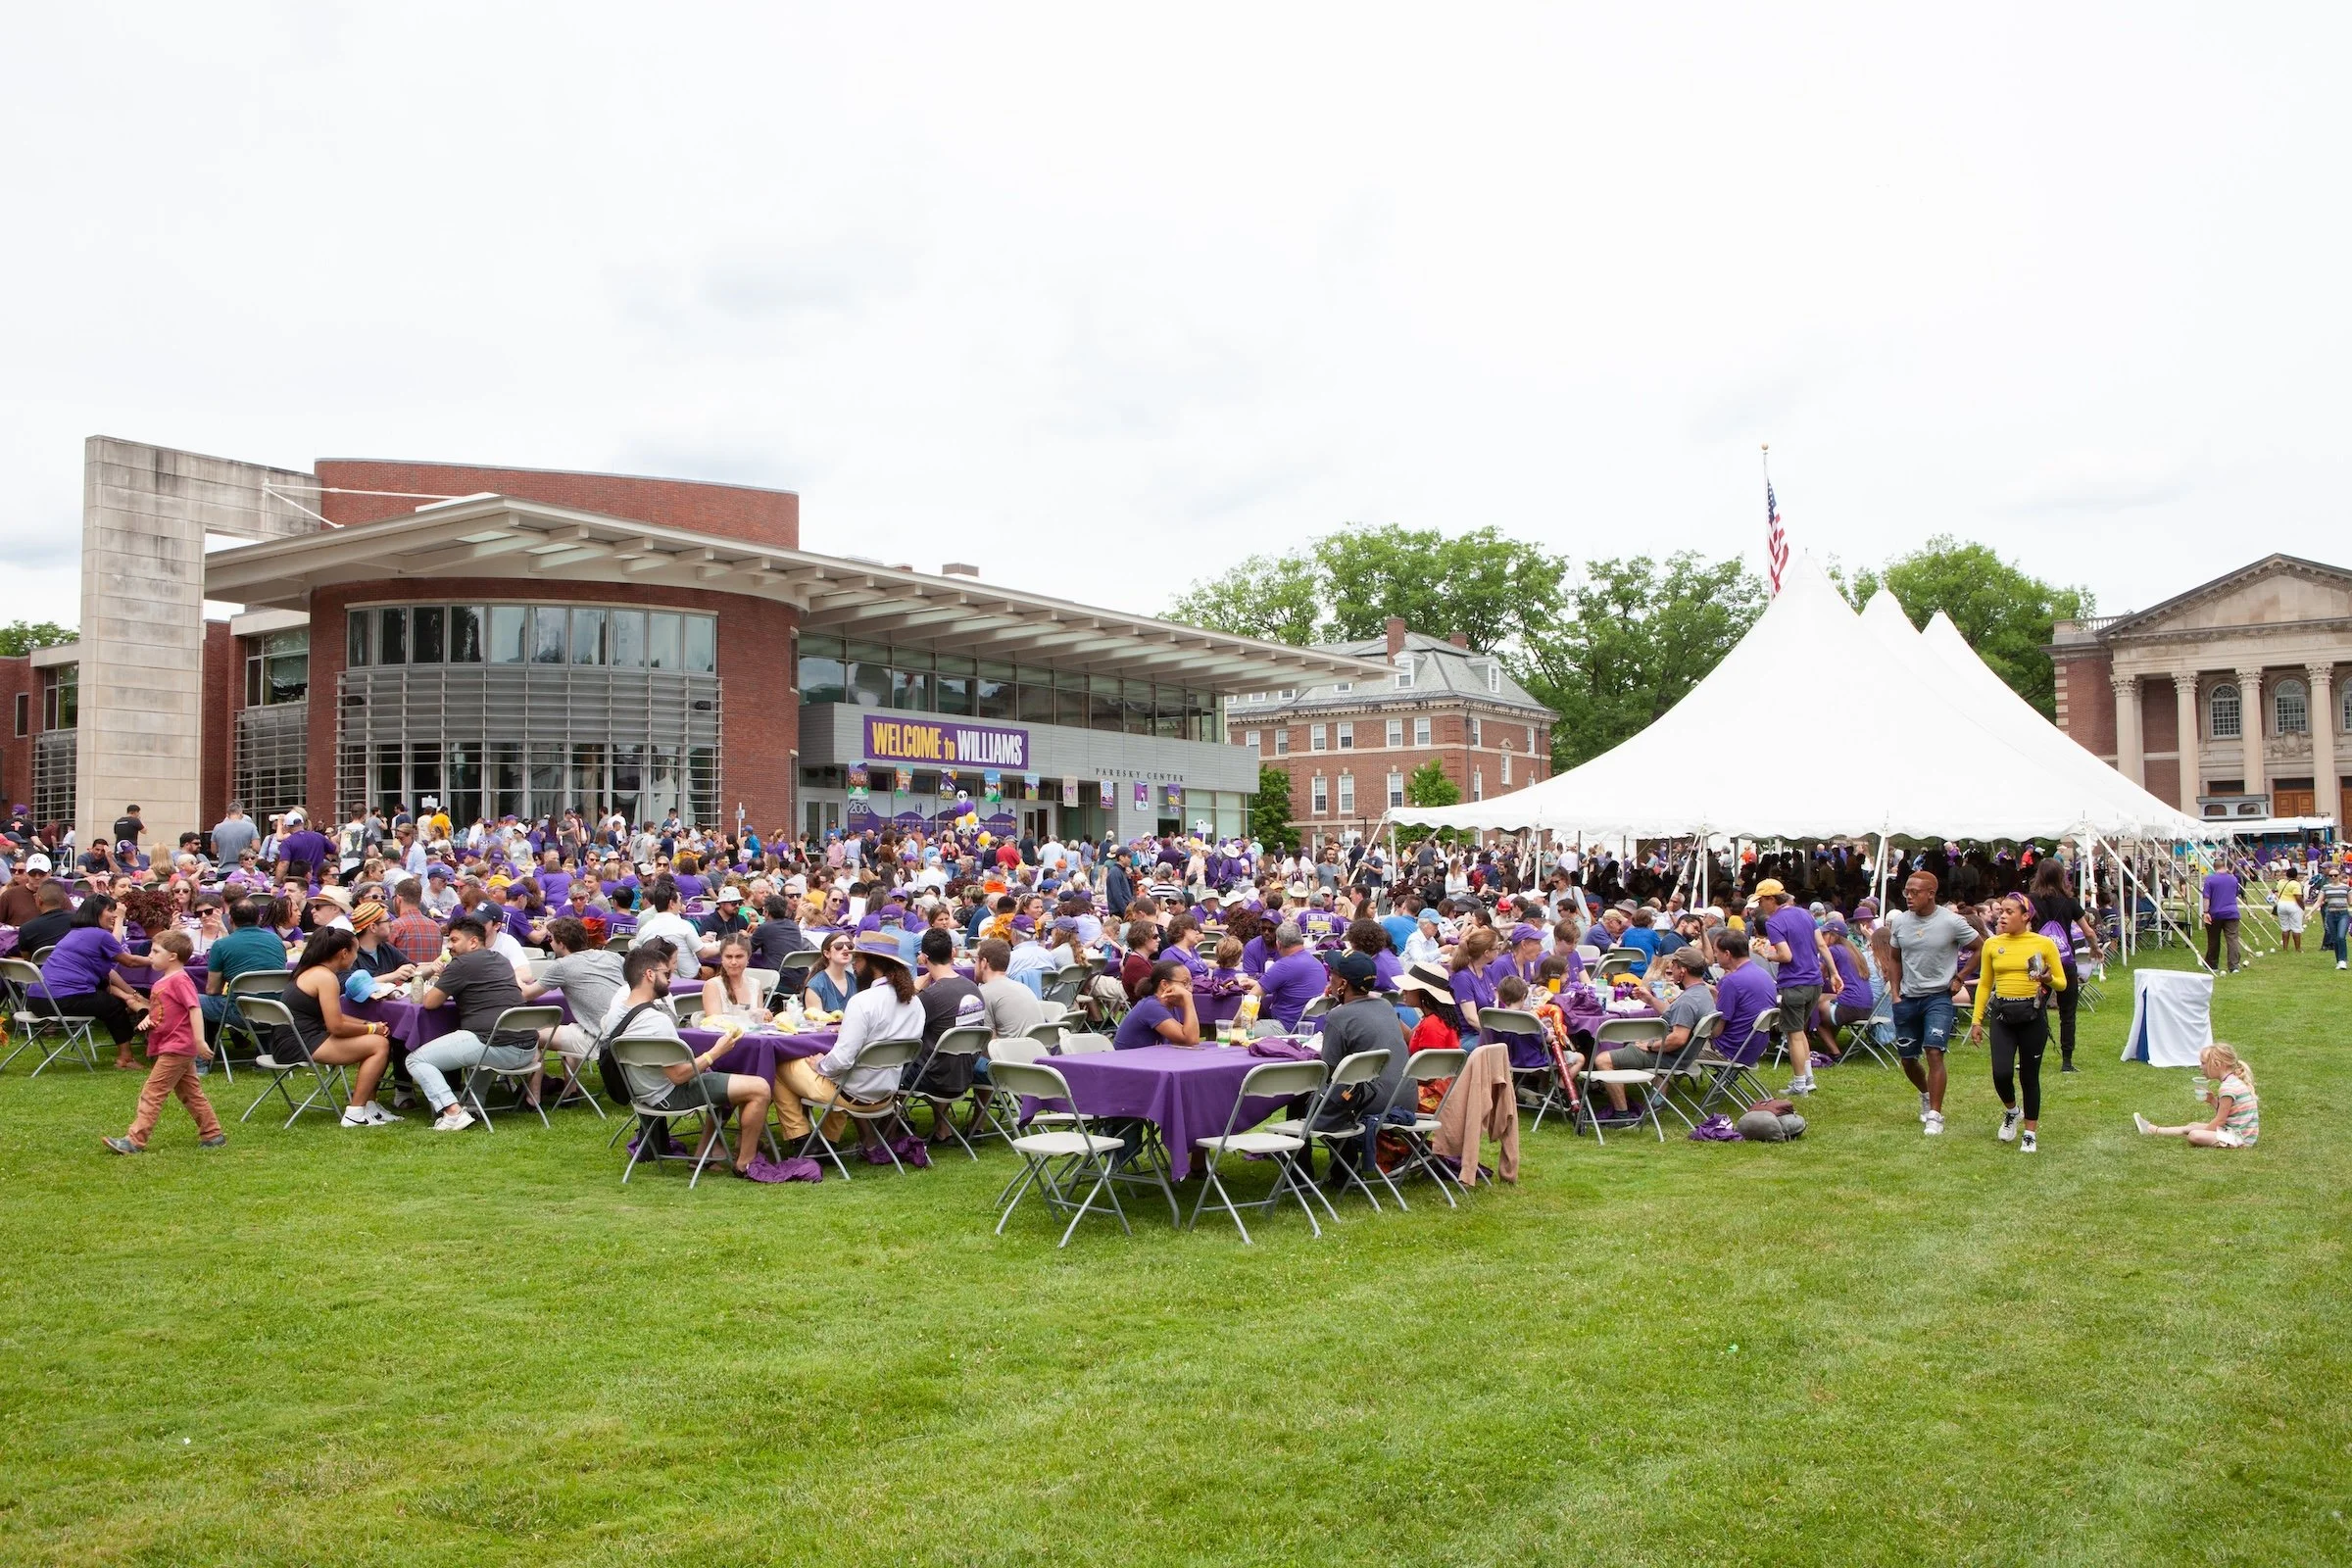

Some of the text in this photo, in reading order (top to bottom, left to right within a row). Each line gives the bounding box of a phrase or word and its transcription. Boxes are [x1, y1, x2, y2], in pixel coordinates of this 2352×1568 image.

[872, 721, 1023, 766] WELCOME to WILLIAMS
[1096, 767, 1184, 782] PARESKY CENTER
